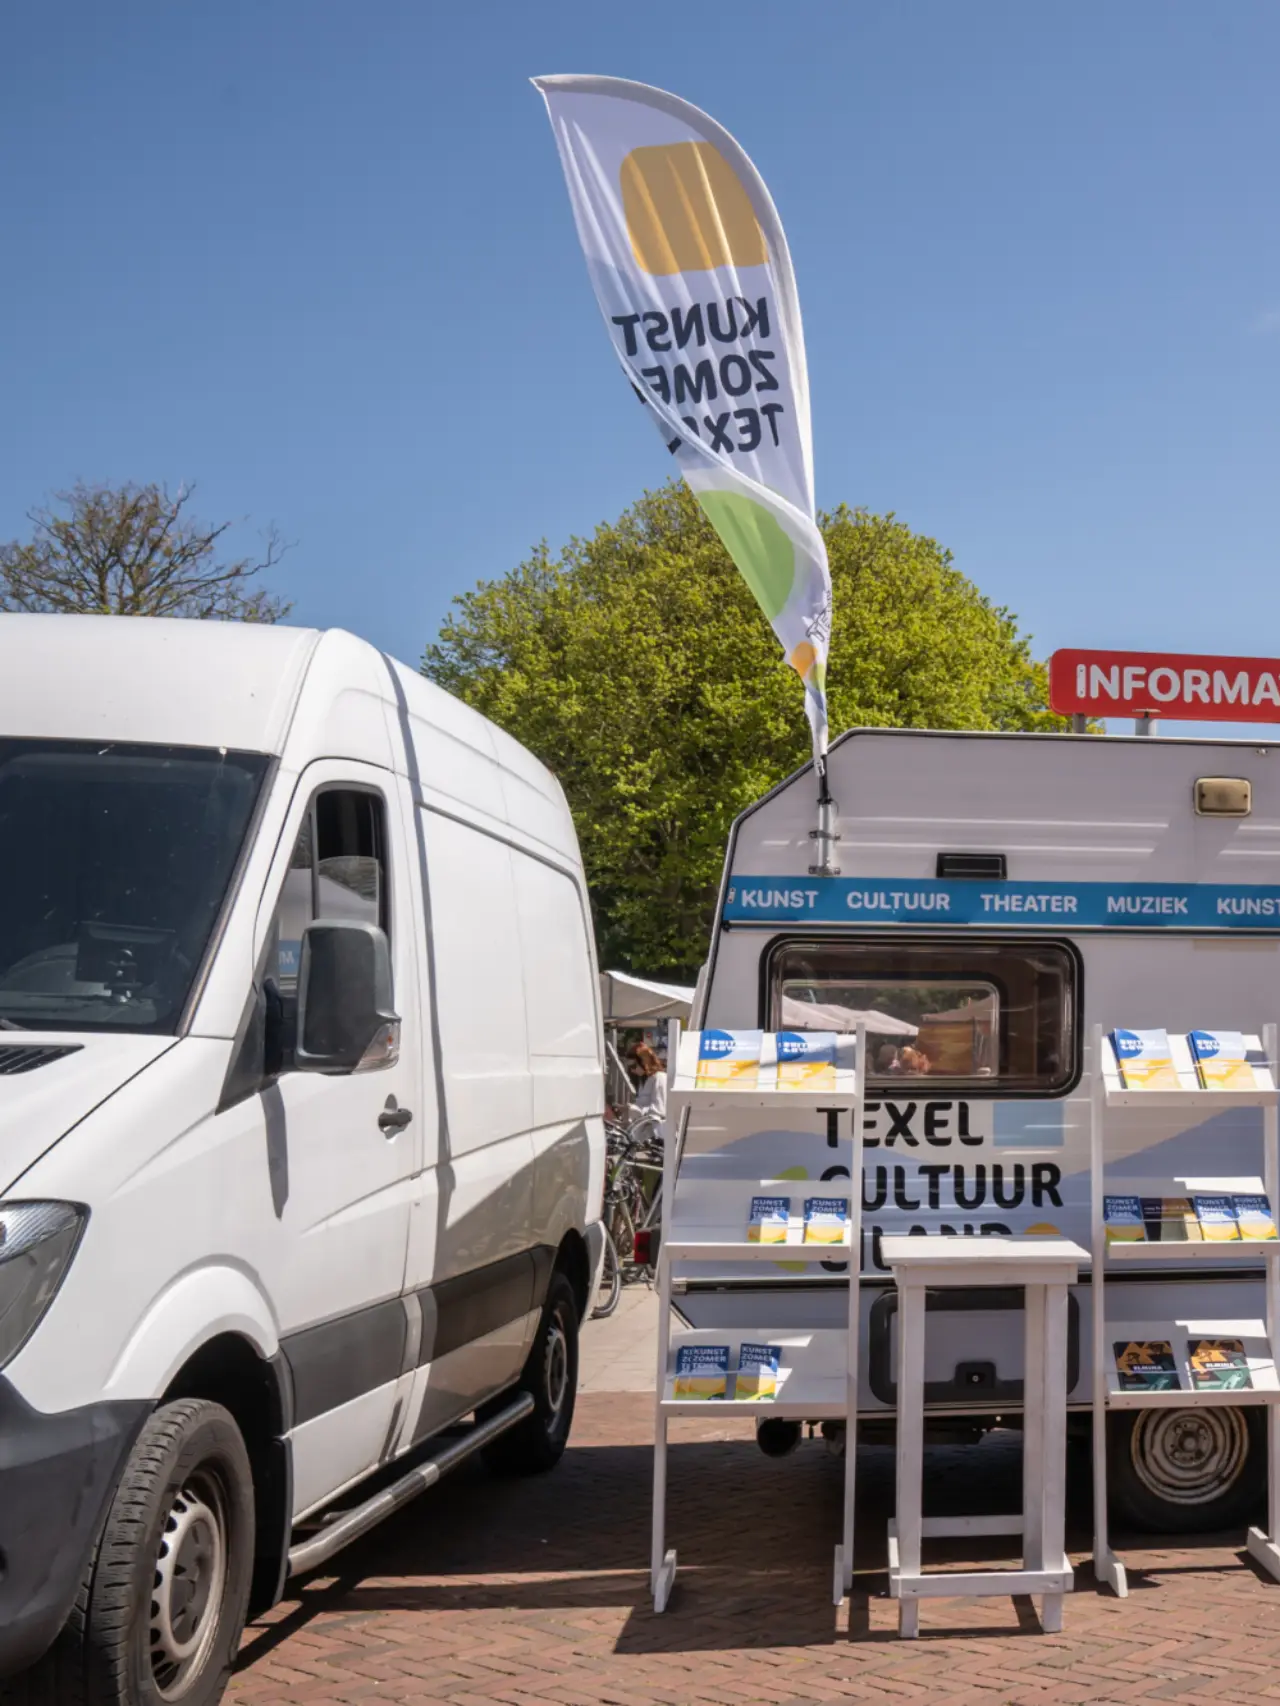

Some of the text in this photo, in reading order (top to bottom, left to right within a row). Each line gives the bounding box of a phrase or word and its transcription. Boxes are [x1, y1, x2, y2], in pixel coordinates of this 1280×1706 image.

[741, 890, 819, 908] KUNST
[847, 891, 950, 911] CULTUUR
[980, 893, 1078, 913] THEATER
[1107, 895, 1188, 914] MUZIEK
[816, 1101, 984, 1148] TEXEL
